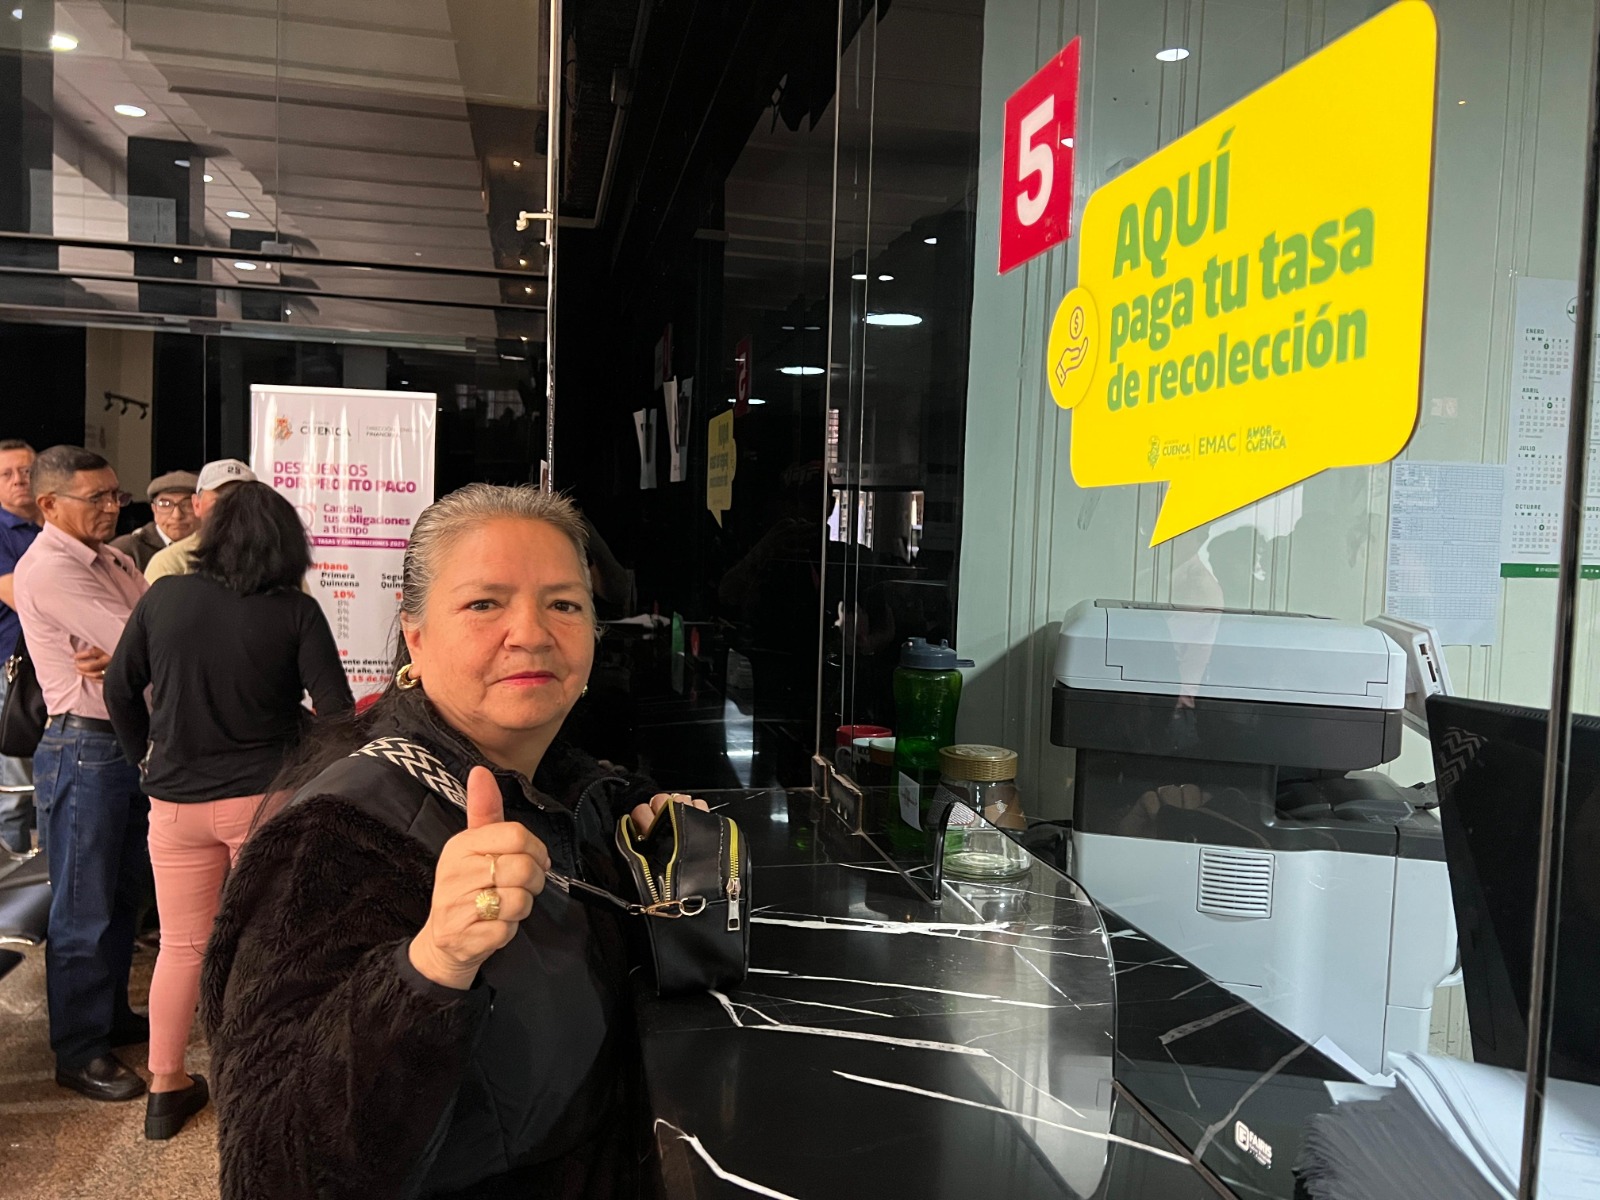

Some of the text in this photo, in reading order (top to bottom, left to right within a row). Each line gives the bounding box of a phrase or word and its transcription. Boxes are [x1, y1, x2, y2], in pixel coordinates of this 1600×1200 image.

[1016, 94, 1055, 227] 5
[1112, 125, 1236, 279] AQUÍ
[1109, 207, 1375, 364] paga tu tasa
[1106, 301, 1368, 412] de recolección
[300, 425, 351, 437] CENCA
[1246, 425, 1272, 439] AMOR
[1162, 443, 1190, 456] CUENCA
[1198, 433, 1237, 455] EMAC
[274, 461, 368, 477] DESUENOS
[375, 480, 417, 493] PAGO
[323, 503, 363, 514] Cancela
[323, 515, 411, 526] tus obligaciones
[332, 525, 369, 536] tiempo
[321, 571, 404, 582] Primera Segu
[320, 580, 403, 589] Quincena Quin
[333, 590, 356, 599] 10%
